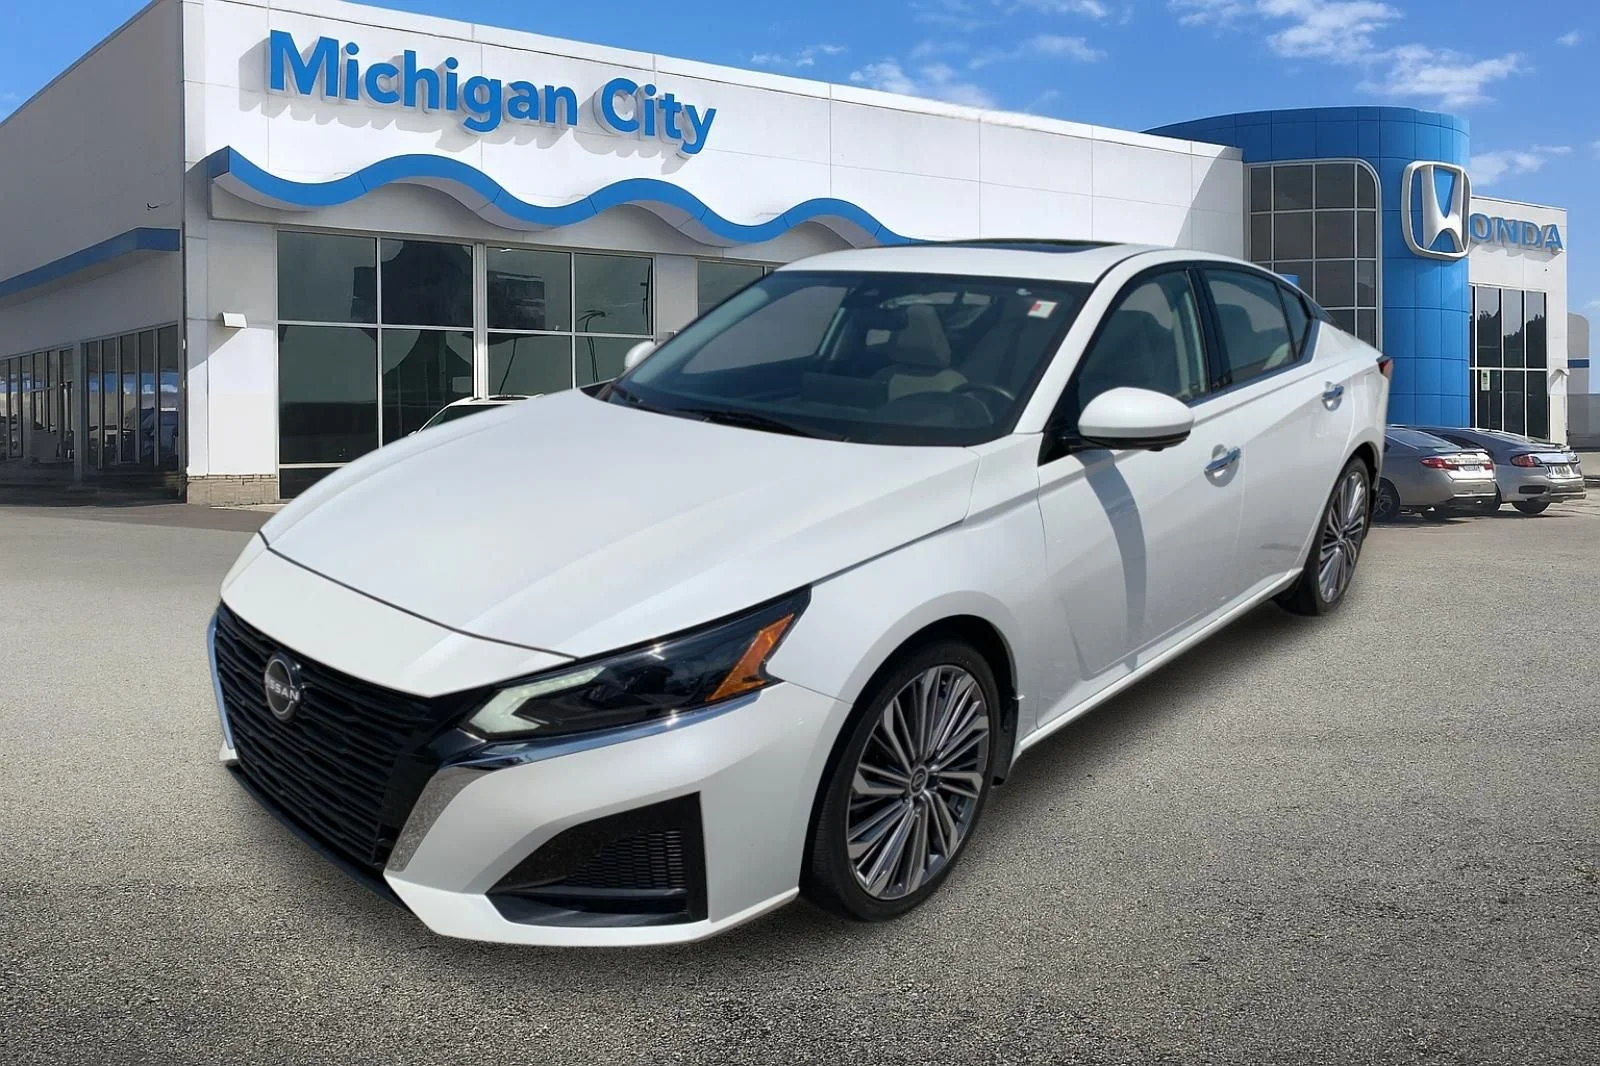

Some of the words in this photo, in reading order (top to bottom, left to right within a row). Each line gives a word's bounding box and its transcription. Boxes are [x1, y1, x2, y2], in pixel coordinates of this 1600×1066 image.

[271, 30, 579, 133] Michigan
[601, 77, 717, 155] City
[1470, 212, 1564, 249] ONDA
[266, 676, 300, 701] SSAN
